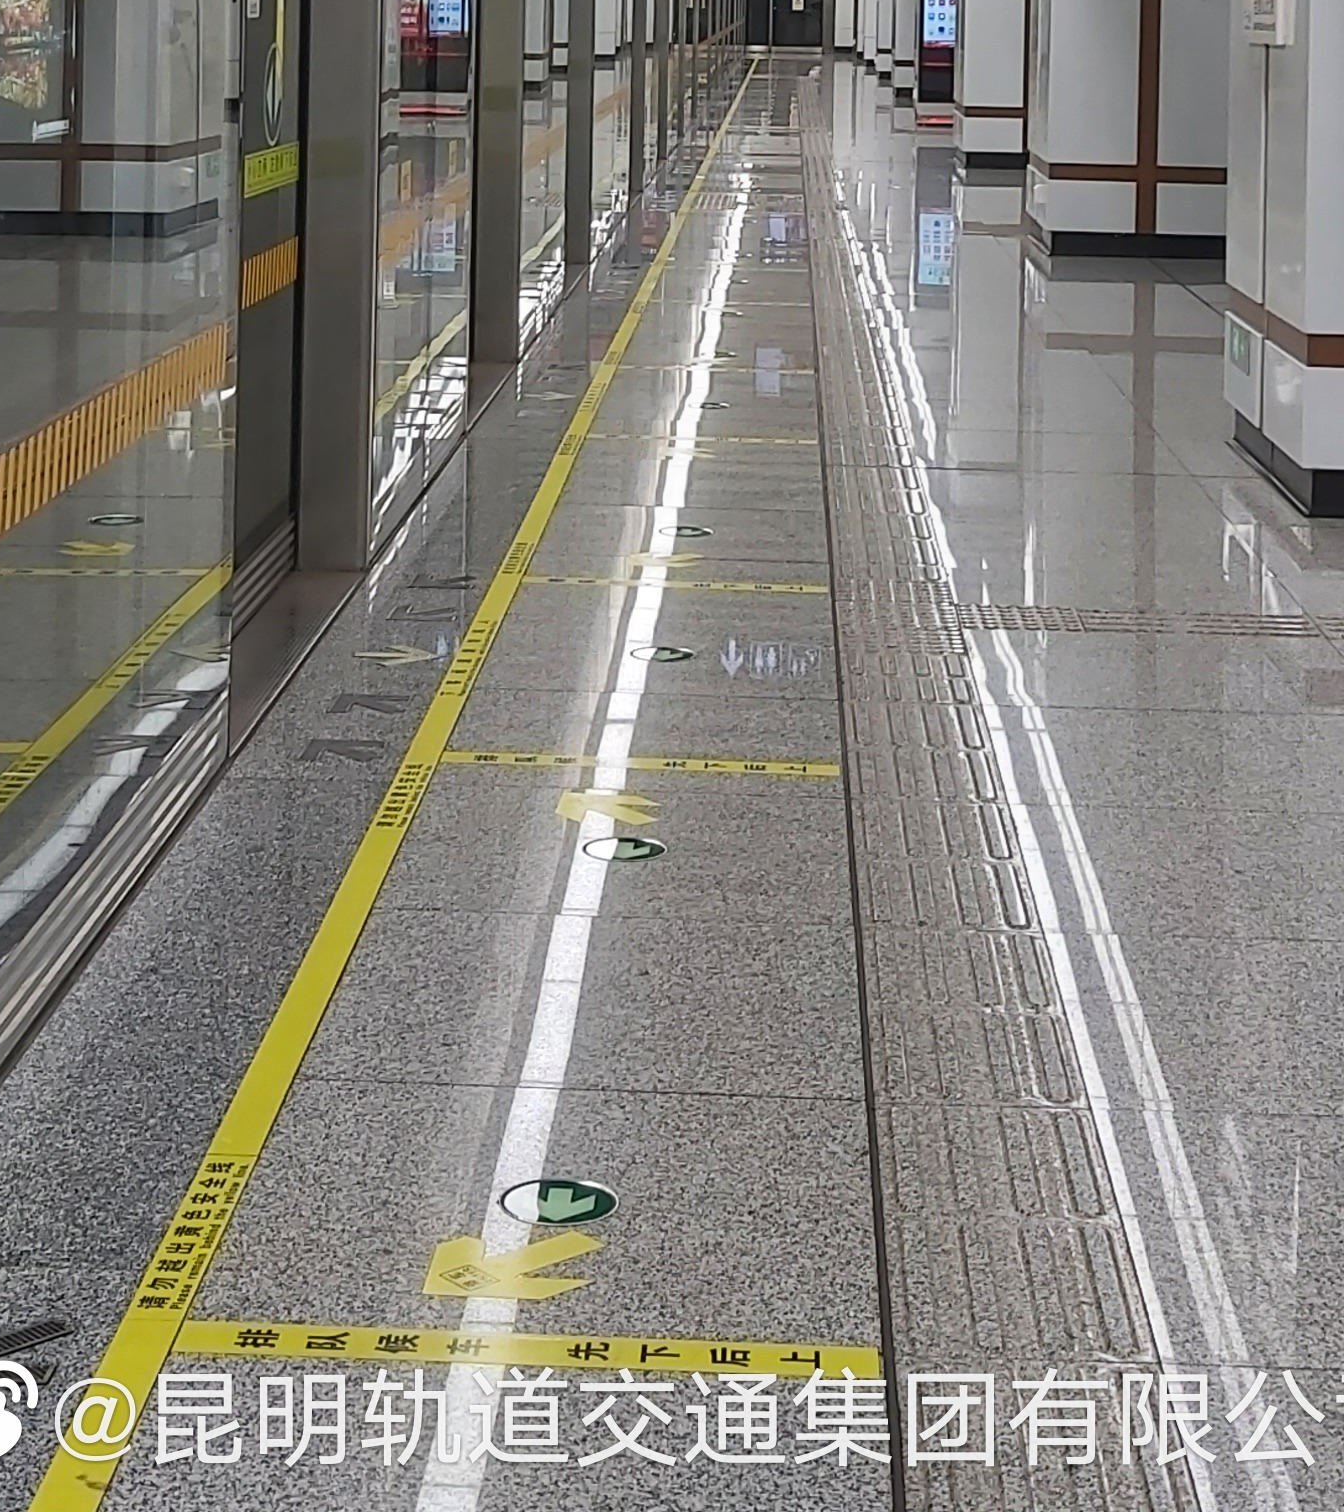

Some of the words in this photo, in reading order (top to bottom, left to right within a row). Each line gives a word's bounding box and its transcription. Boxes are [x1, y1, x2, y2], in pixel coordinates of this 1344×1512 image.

[234, 1328, 491, 1357] 排队候车
[567, 1341, 822, 1371] 先下后上
